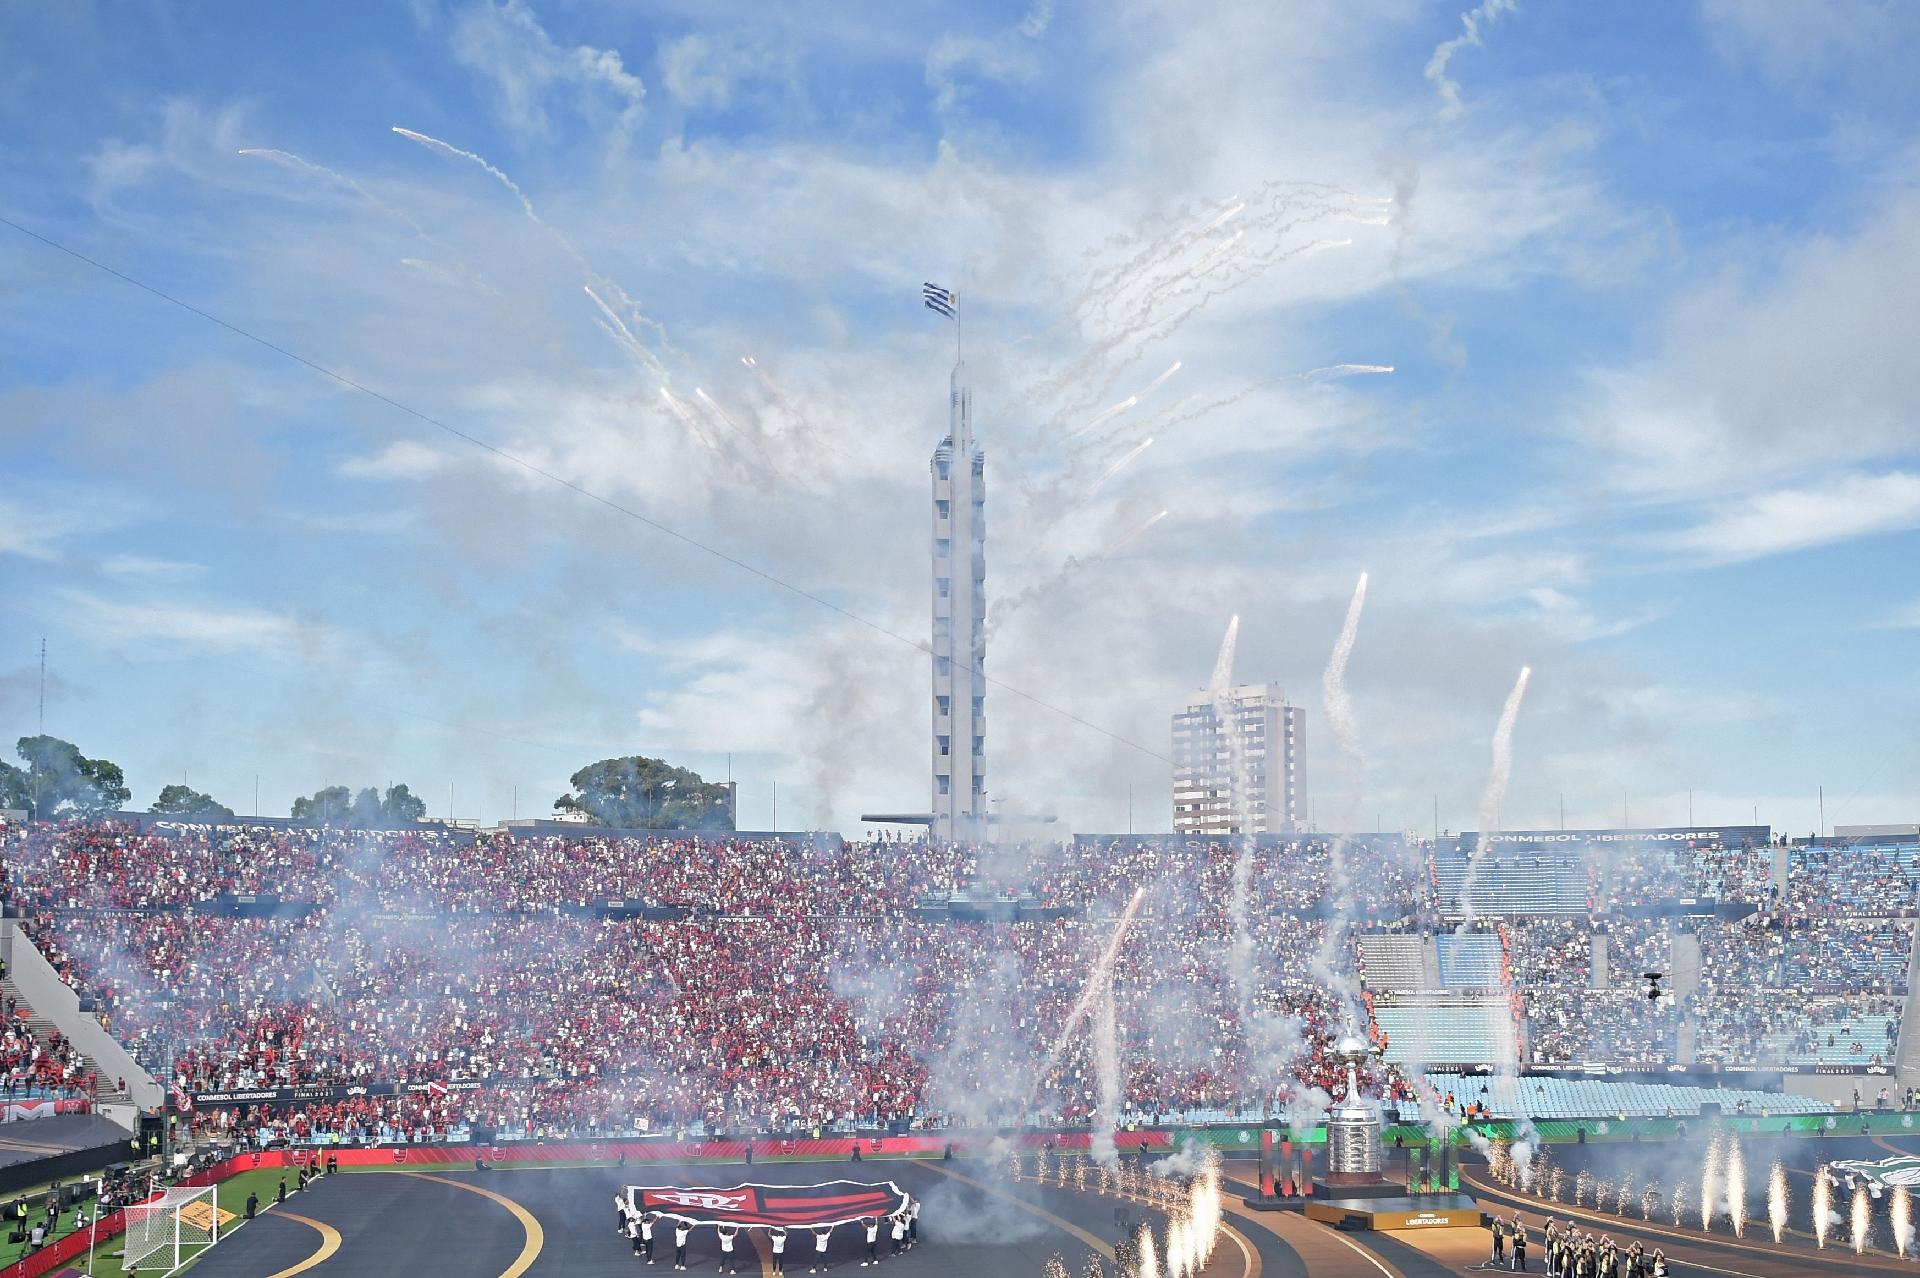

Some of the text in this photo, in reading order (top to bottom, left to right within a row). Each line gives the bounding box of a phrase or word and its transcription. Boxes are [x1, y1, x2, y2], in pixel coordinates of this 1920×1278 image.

[197, 1091, 277, 1101] CONMEBOL LIBERTADORES
[1406, 1218, 1449, 1226] LIBERTADORES
